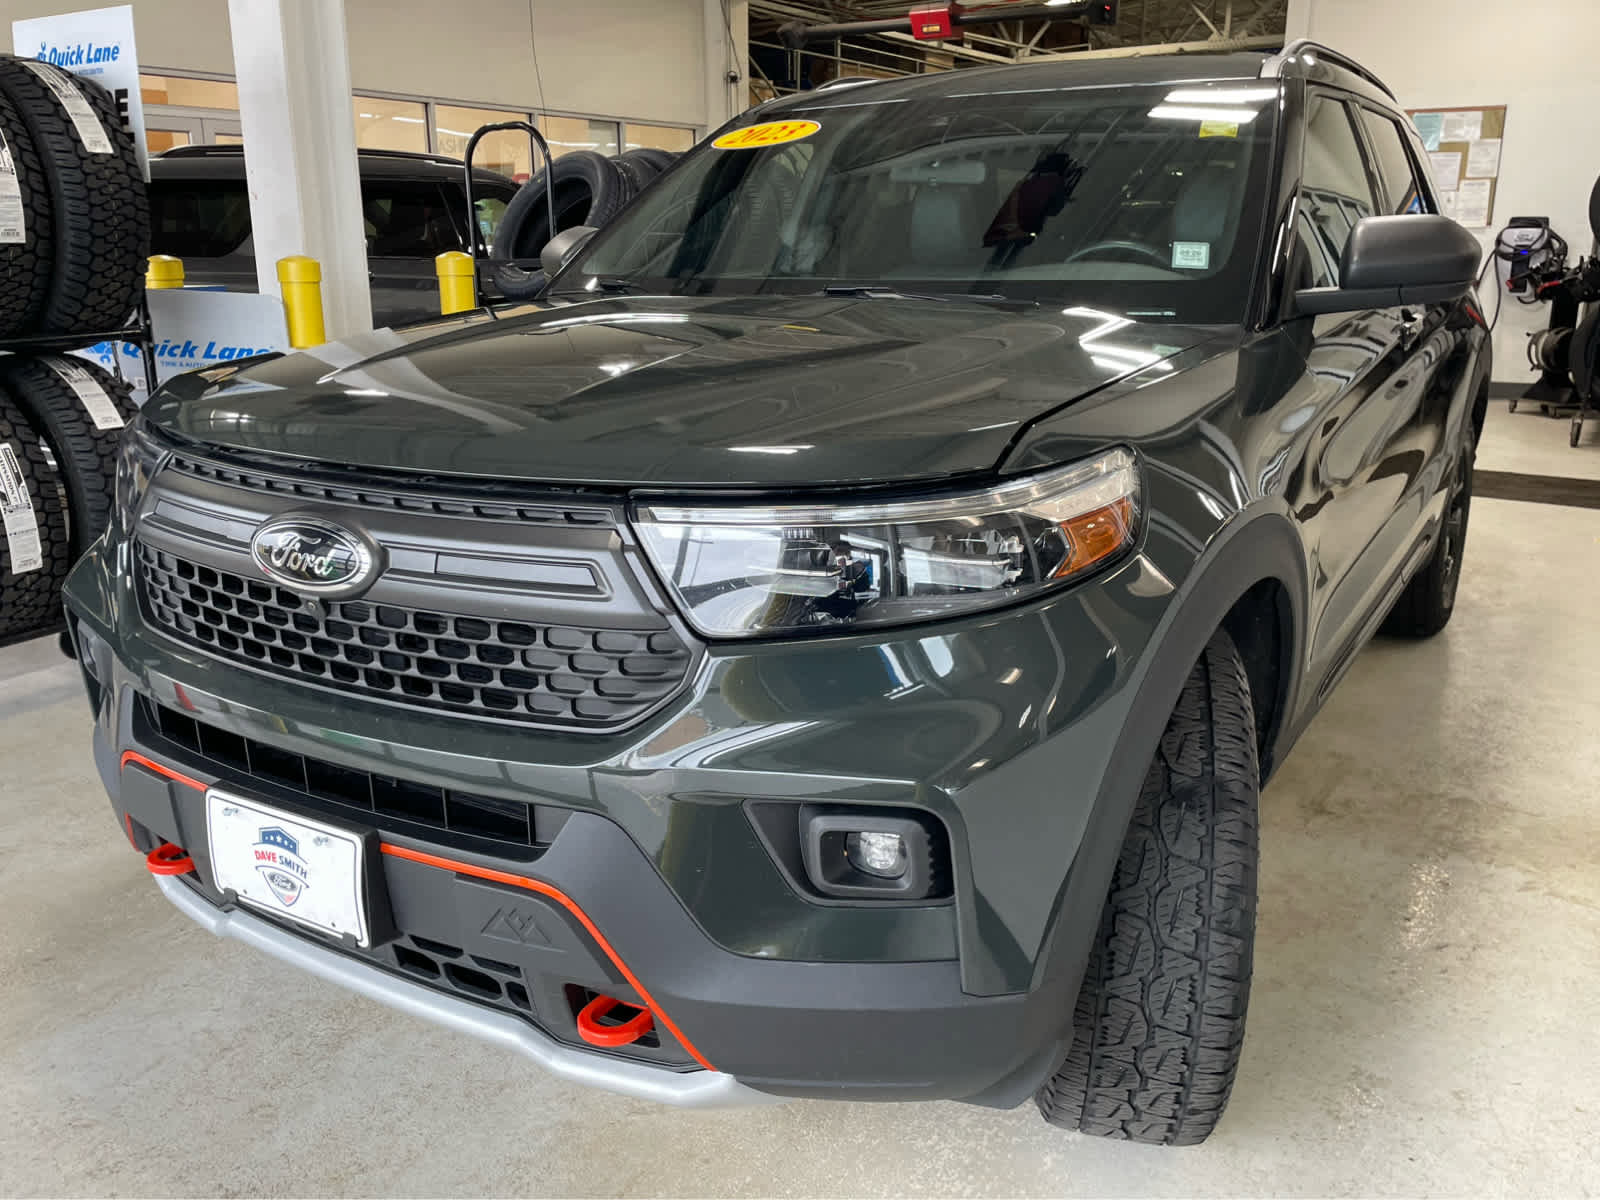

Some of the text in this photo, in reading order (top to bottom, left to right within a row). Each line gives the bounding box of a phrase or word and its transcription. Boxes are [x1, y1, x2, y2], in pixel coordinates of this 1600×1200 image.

[49, 43, 119, 66] Quick Lane
[122, 339, 199, 359] Qick
[270, 531, 334, 577] Ford
[254, 850, 307, 880] DAVE SMITH
